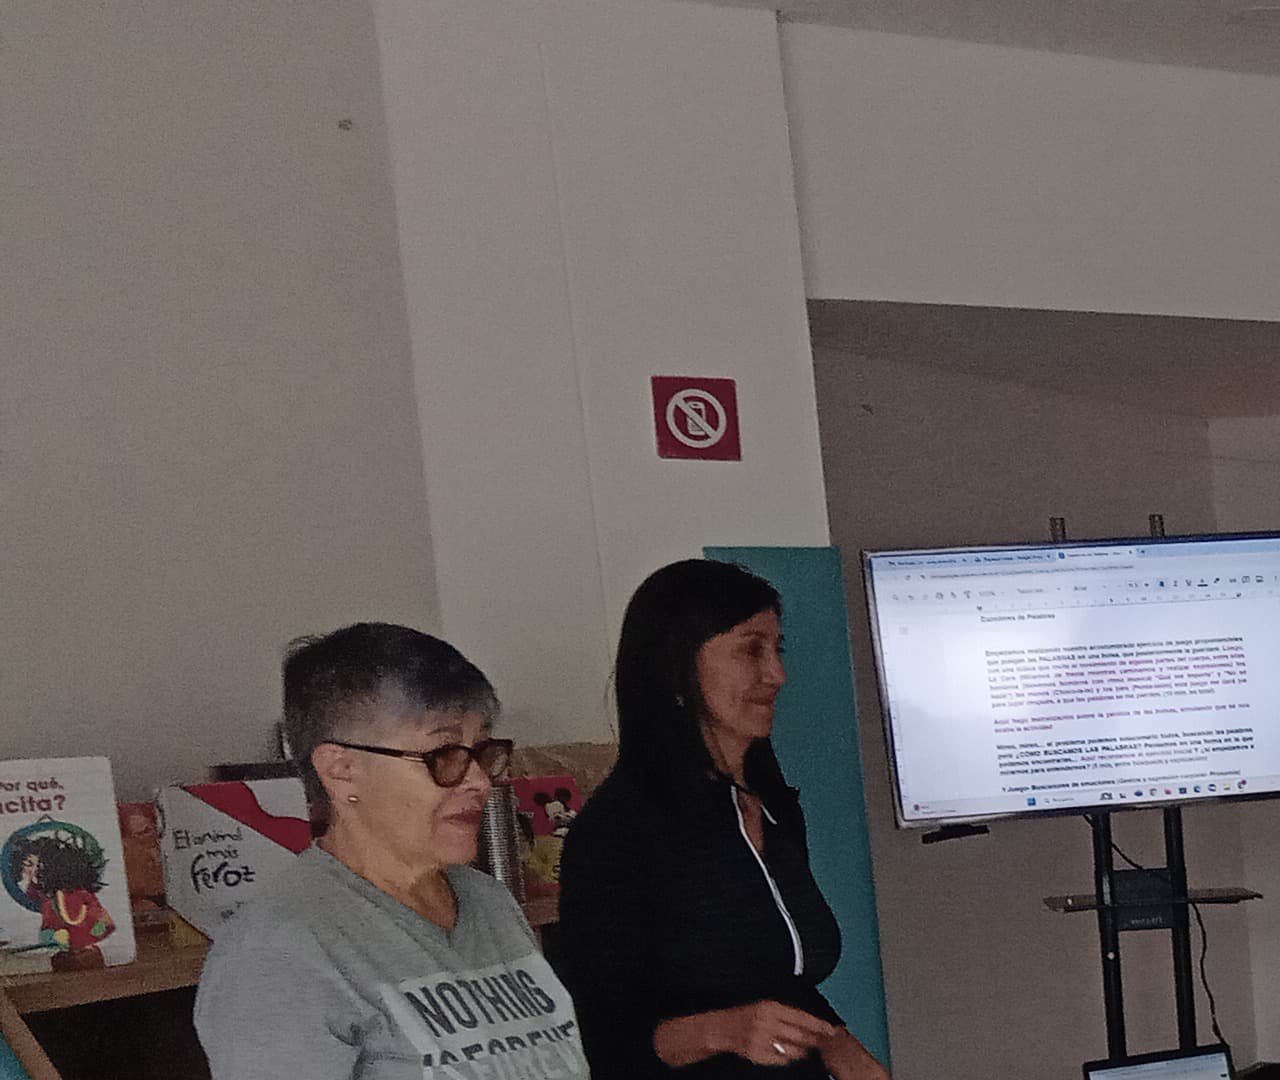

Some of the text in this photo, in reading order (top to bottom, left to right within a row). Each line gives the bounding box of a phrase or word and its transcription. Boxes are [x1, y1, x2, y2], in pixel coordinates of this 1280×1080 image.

[172, 826, 245, 850] El animal
[403, 967, 557, 1039] NOTHING
